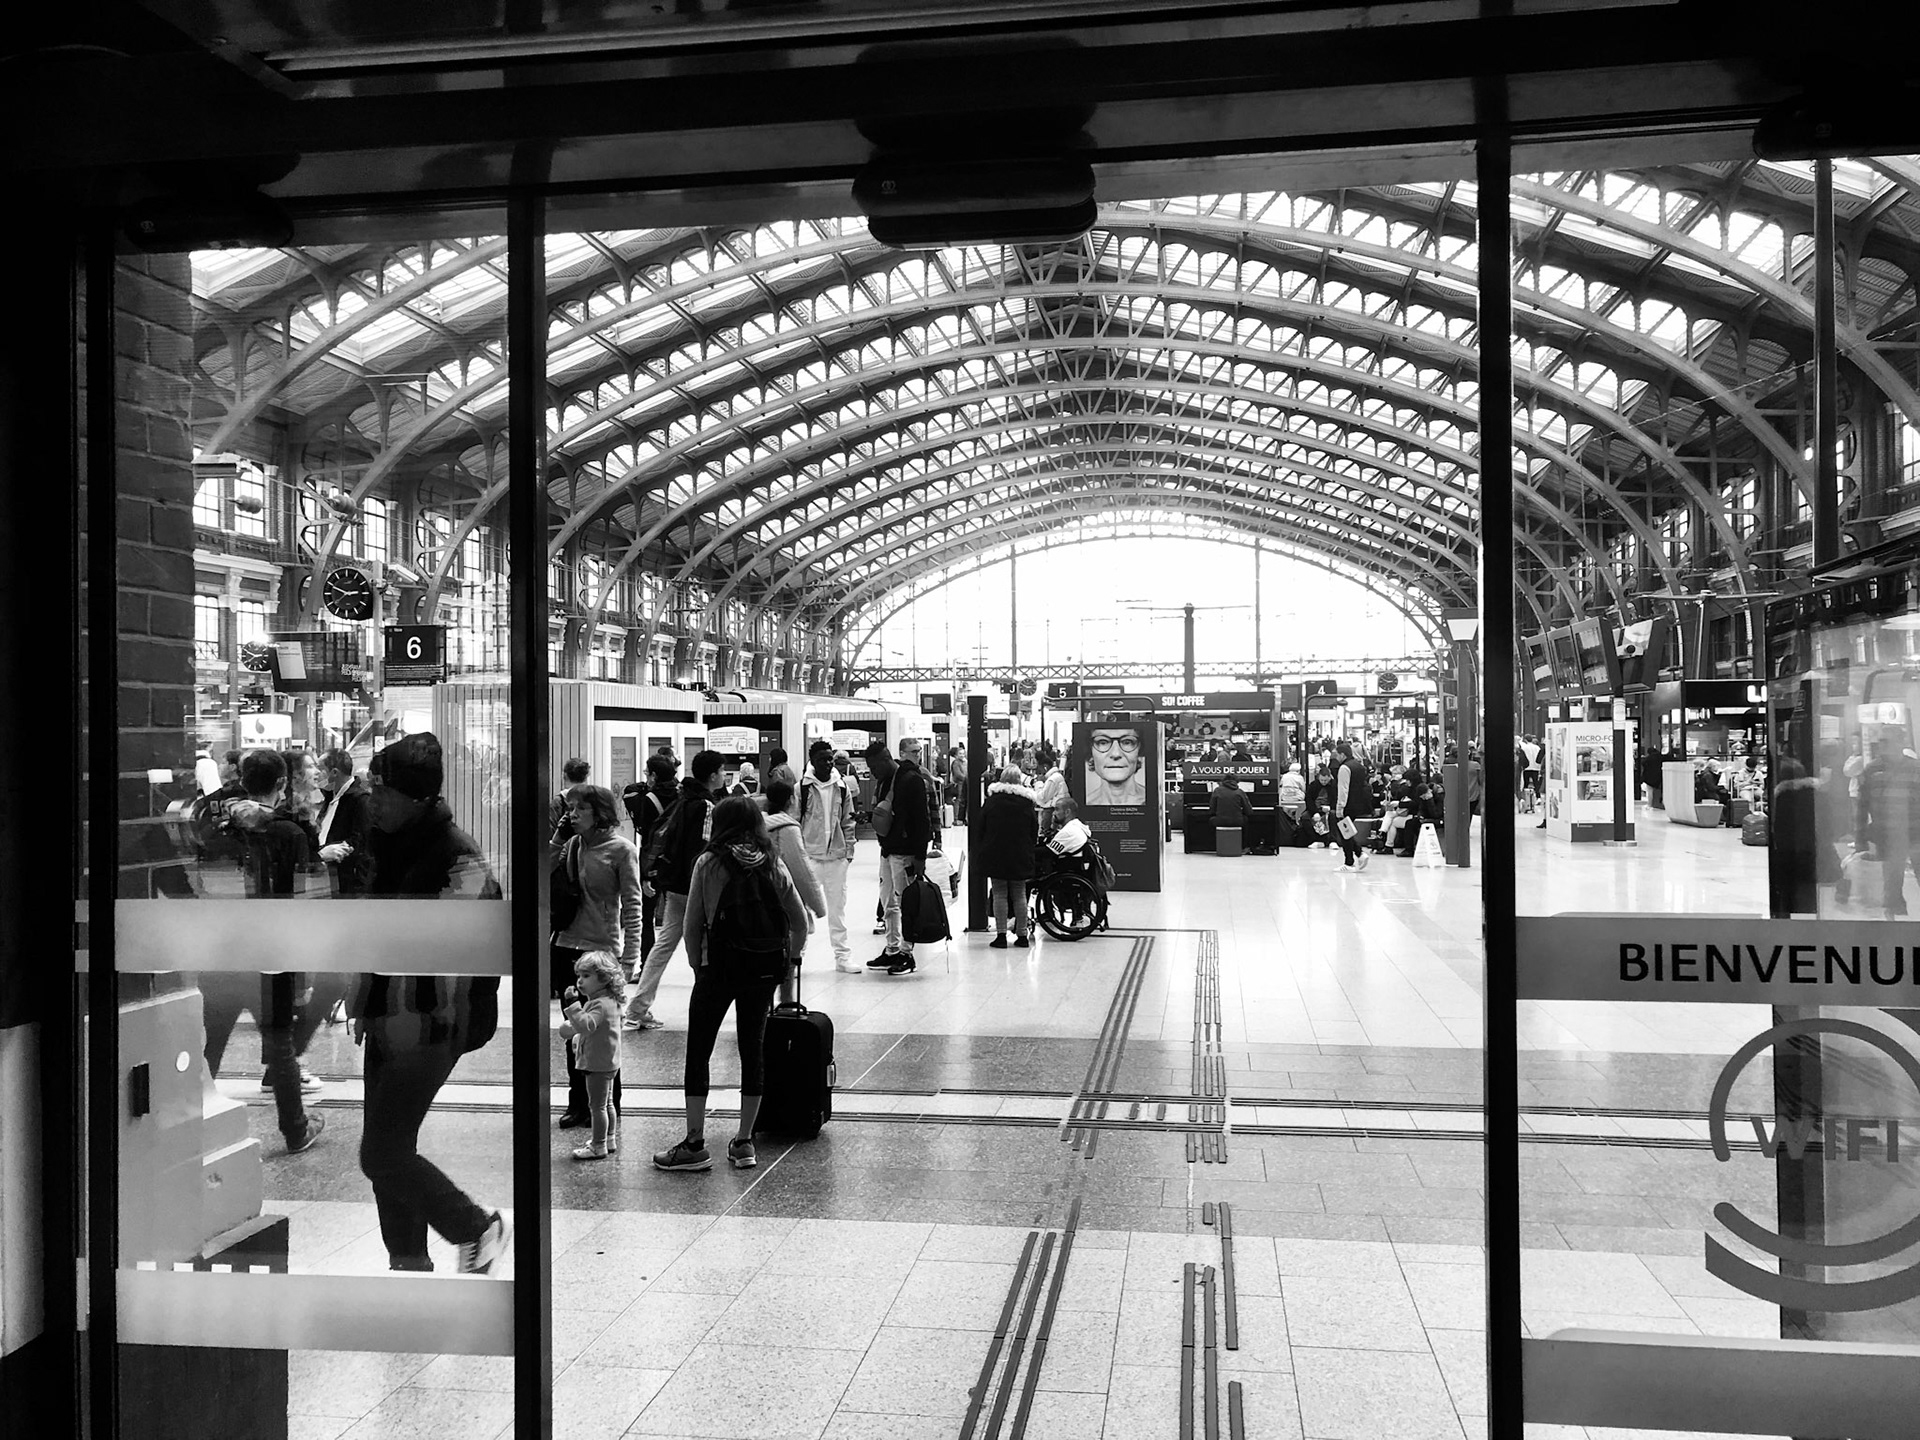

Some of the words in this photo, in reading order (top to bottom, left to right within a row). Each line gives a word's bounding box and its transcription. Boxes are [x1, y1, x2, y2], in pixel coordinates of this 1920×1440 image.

[407, 636, 422, 659] 6
[1009, 684, 1016, 693] J
[1059, 687, 1067, 698] 5
[1317, 685, 1326, 696] 4
[1161, 696, 1175, 706] SO!
[1177, 695, 1205, 706] COFFEE
[1190, 765, 1198, 774] À
[1199, 766, 1221, 774] VOUS
[1223, 766, 1235, 774] DE
[1236, 766, 1265, 774] JOUER
[1750, 1116, 1899, 1162] WIFI
